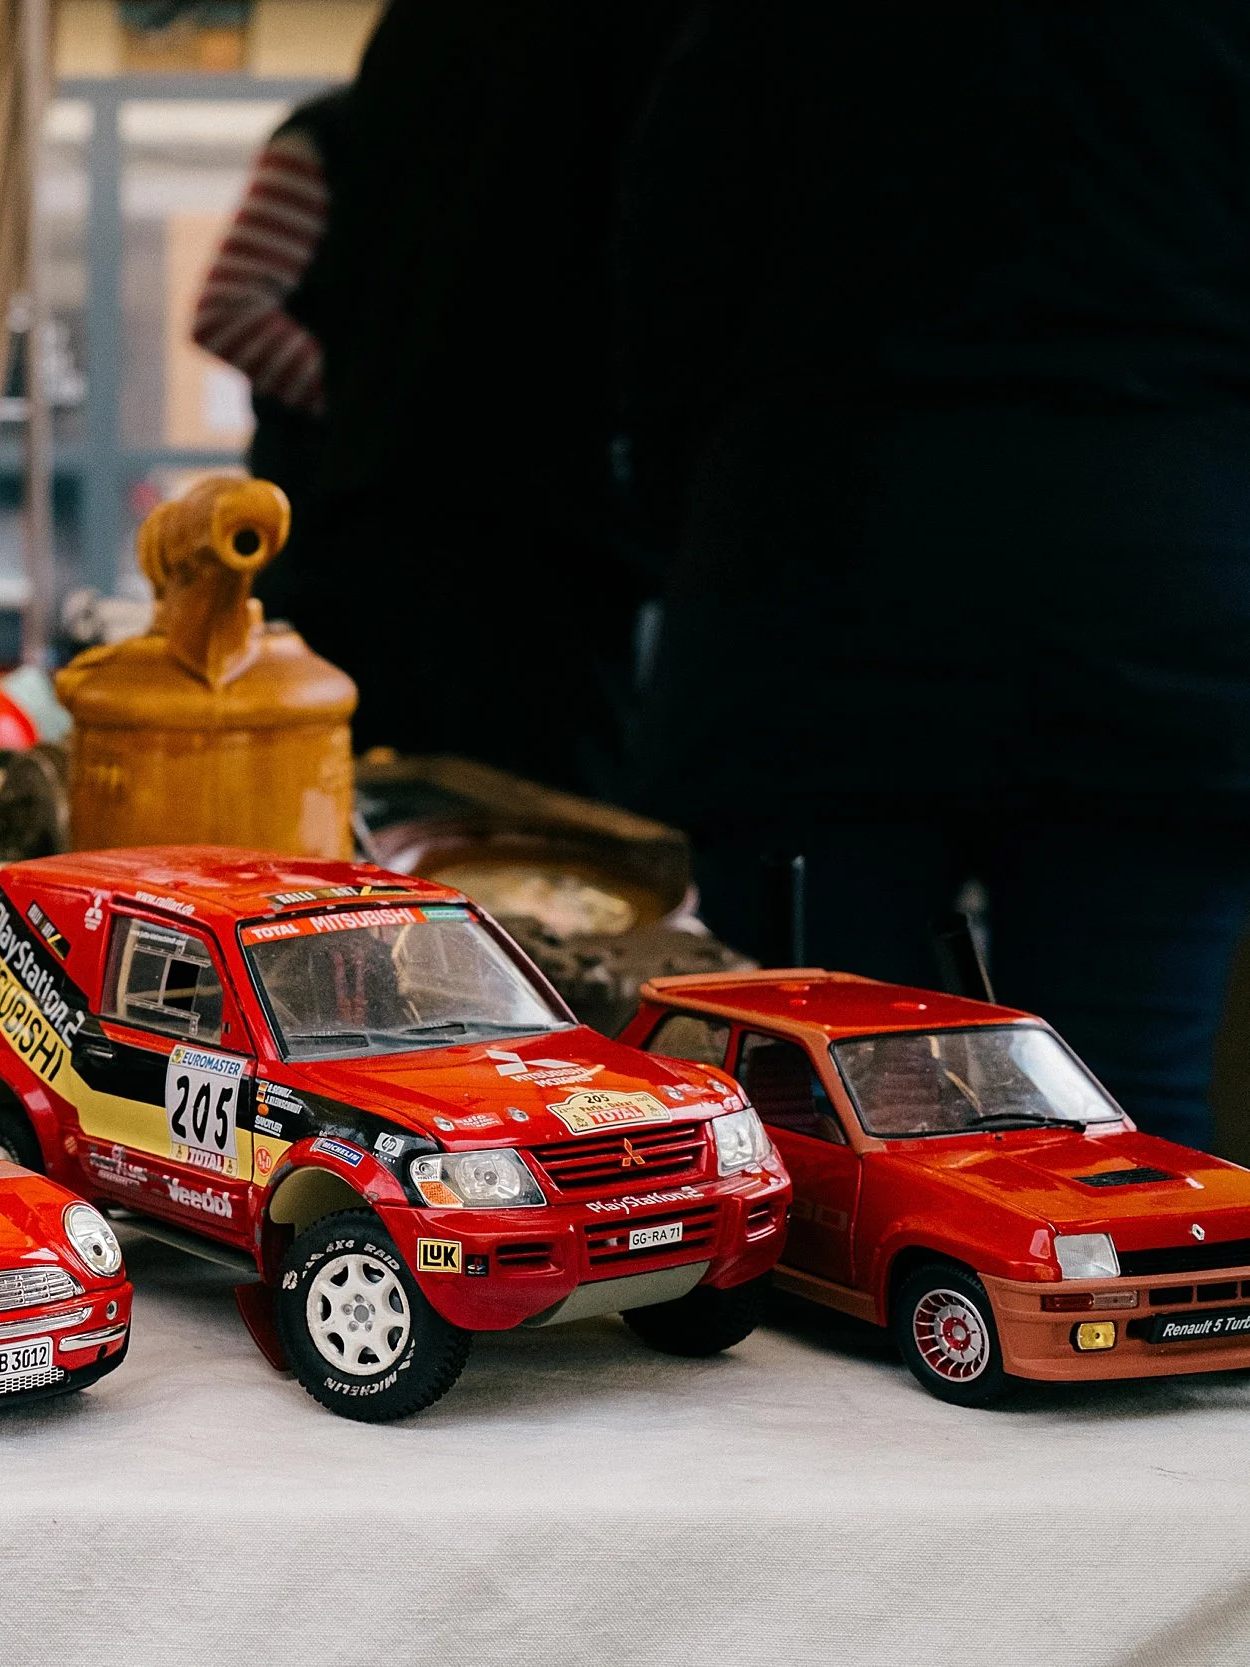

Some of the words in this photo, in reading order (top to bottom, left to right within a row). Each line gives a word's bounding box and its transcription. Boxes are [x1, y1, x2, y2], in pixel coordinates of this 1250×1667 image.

[275, 891, 317, 905] RALLI
[309, 907, 417, 932] MITSUBISHI
[250, 923, 300, 940] TOTAL
[181, 1051, 241, 1076] EUROMASTER
[583, 1094, 609, 1104] 205
[171, 1075, 234, 1150] 205
[589, 1107, 644, 1124] TOTAL
[189, 1148, 223, 1172] TOTAL
[321, 1139, 364, 1162] MICHELIN
[632, 1230, 668, 1246] GG-RA
[669, 1226, 681, 1240] 71
[363, 1243, 400, 1271] RAID
[1162, 1320, 1213, 1338] Renault
[1213, 1318, 1224, 1332] 5
[11, 1346, 47, 1370] 3012
[324, 1371, 398, 1397] MICHELIN
